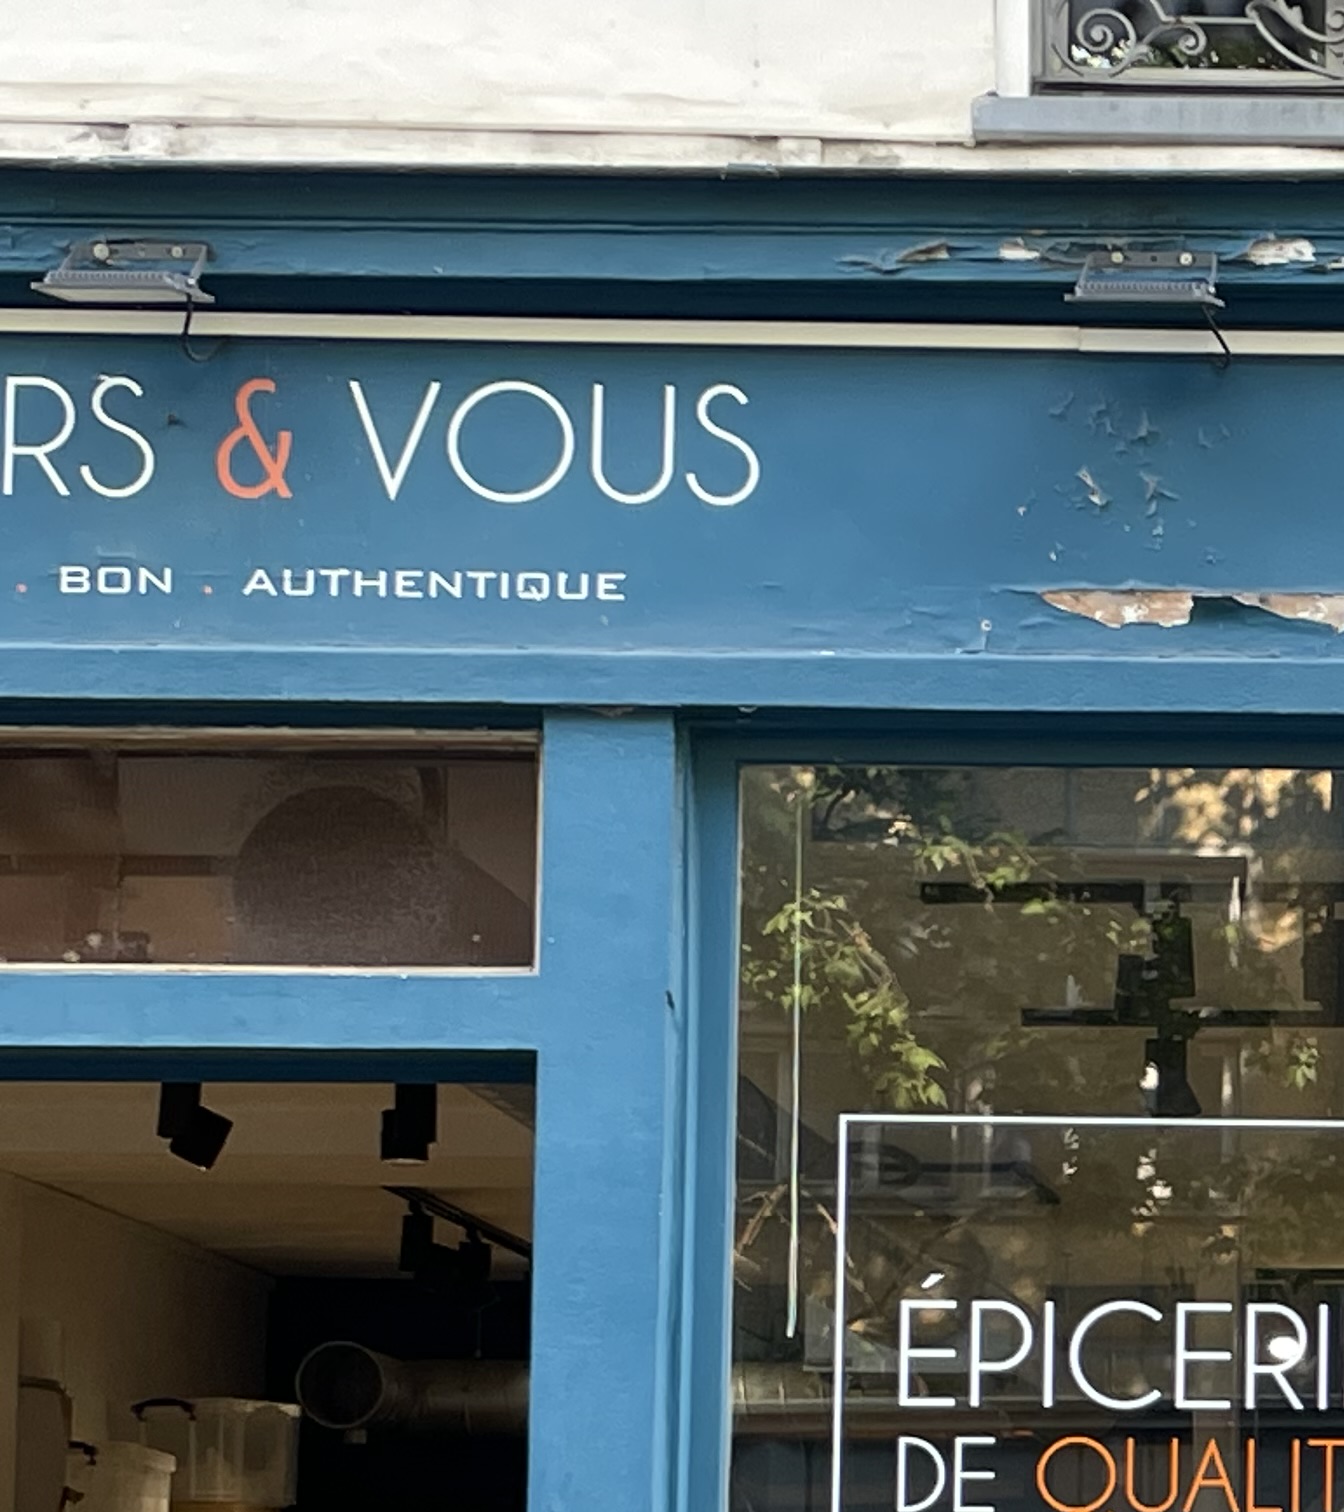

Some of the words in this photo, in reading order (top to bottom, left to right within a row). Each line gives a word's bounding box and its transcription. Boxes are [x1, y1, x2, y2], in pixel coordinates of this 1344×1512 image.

[2, 375, 155, 498] RS
[216, 377, 294, 499] &
[348, 380, 762, 506] VOUS
[58, 565, 173, 595] BON
[242, 567, 628, 602] AUTHENTIQUE
